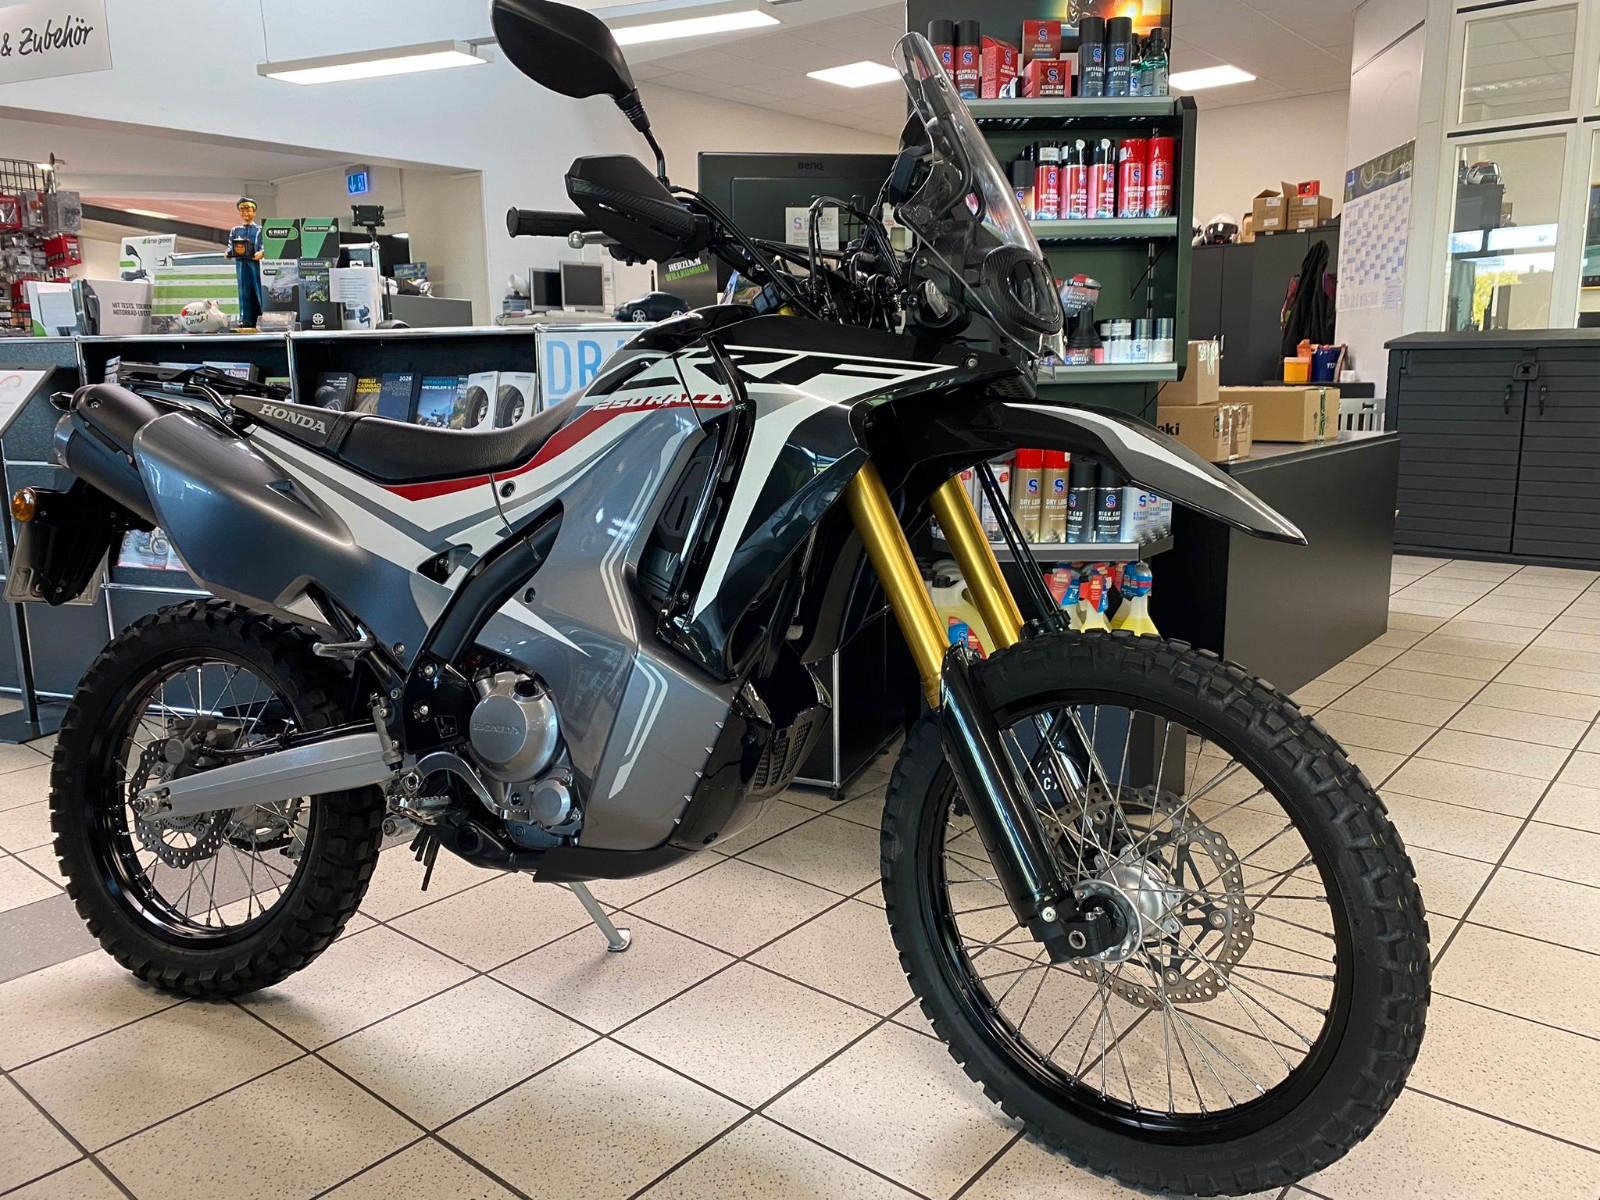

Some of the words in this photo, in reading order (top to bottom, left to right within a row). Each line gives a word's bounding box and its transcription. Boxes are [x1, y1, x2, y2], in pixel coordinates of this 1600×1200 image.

[0, 32, 12, 56] &
[19, 15, 94, 55] Zubehör
[259, 403, 327, 434] HONDA
